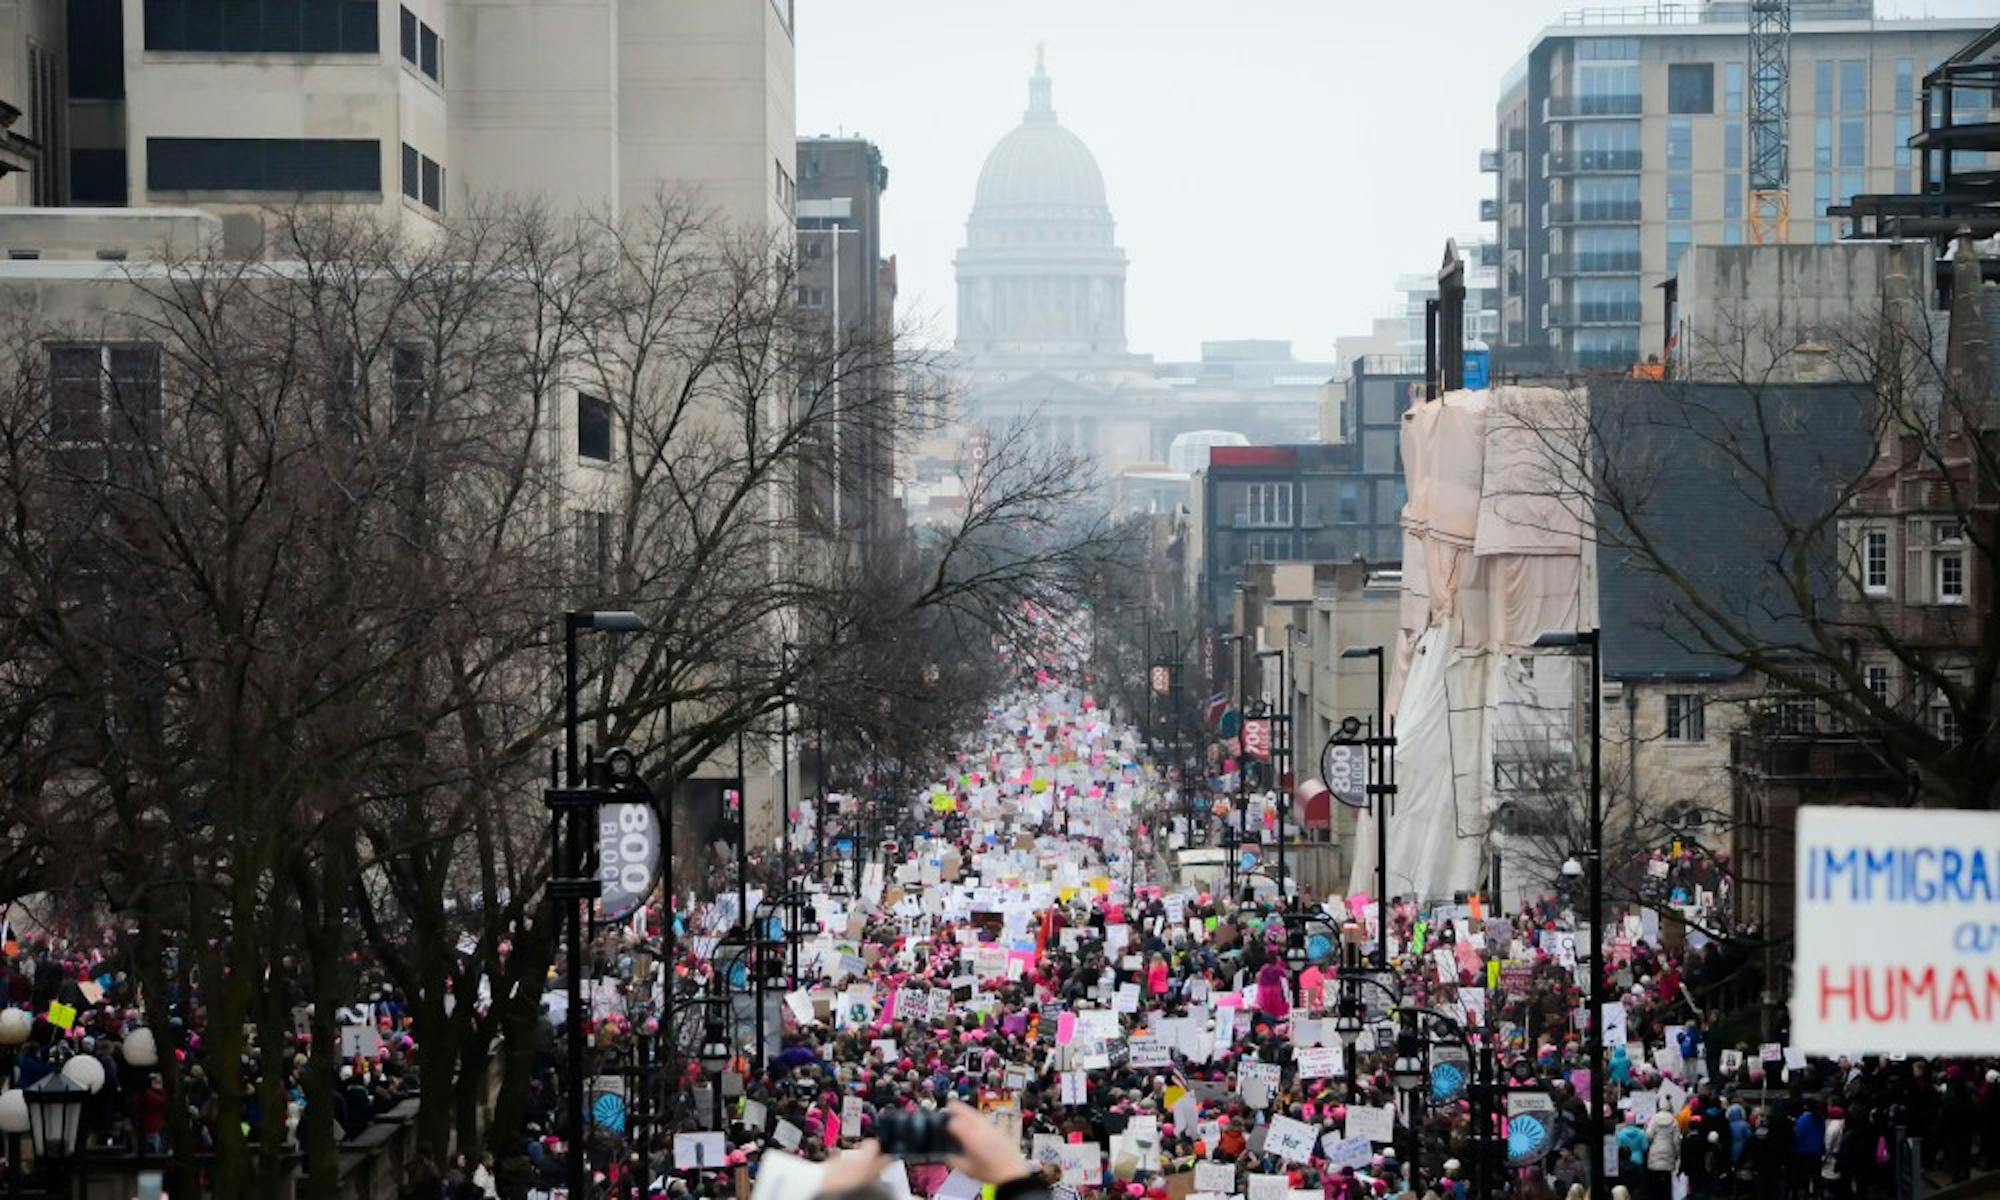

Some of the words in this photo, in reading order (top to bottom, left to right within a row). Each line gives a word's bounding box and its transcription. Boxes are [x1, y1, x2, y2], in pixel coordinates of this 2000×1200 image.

[1332, 745, 1351, 793] 800
[1352, 755, 1363, 793] BLOCK
[601, 822, 619, 893] BLOCK
[620, 804, 649, 893] 800
[1807, 848, 2000, 903] IMMIGRA
